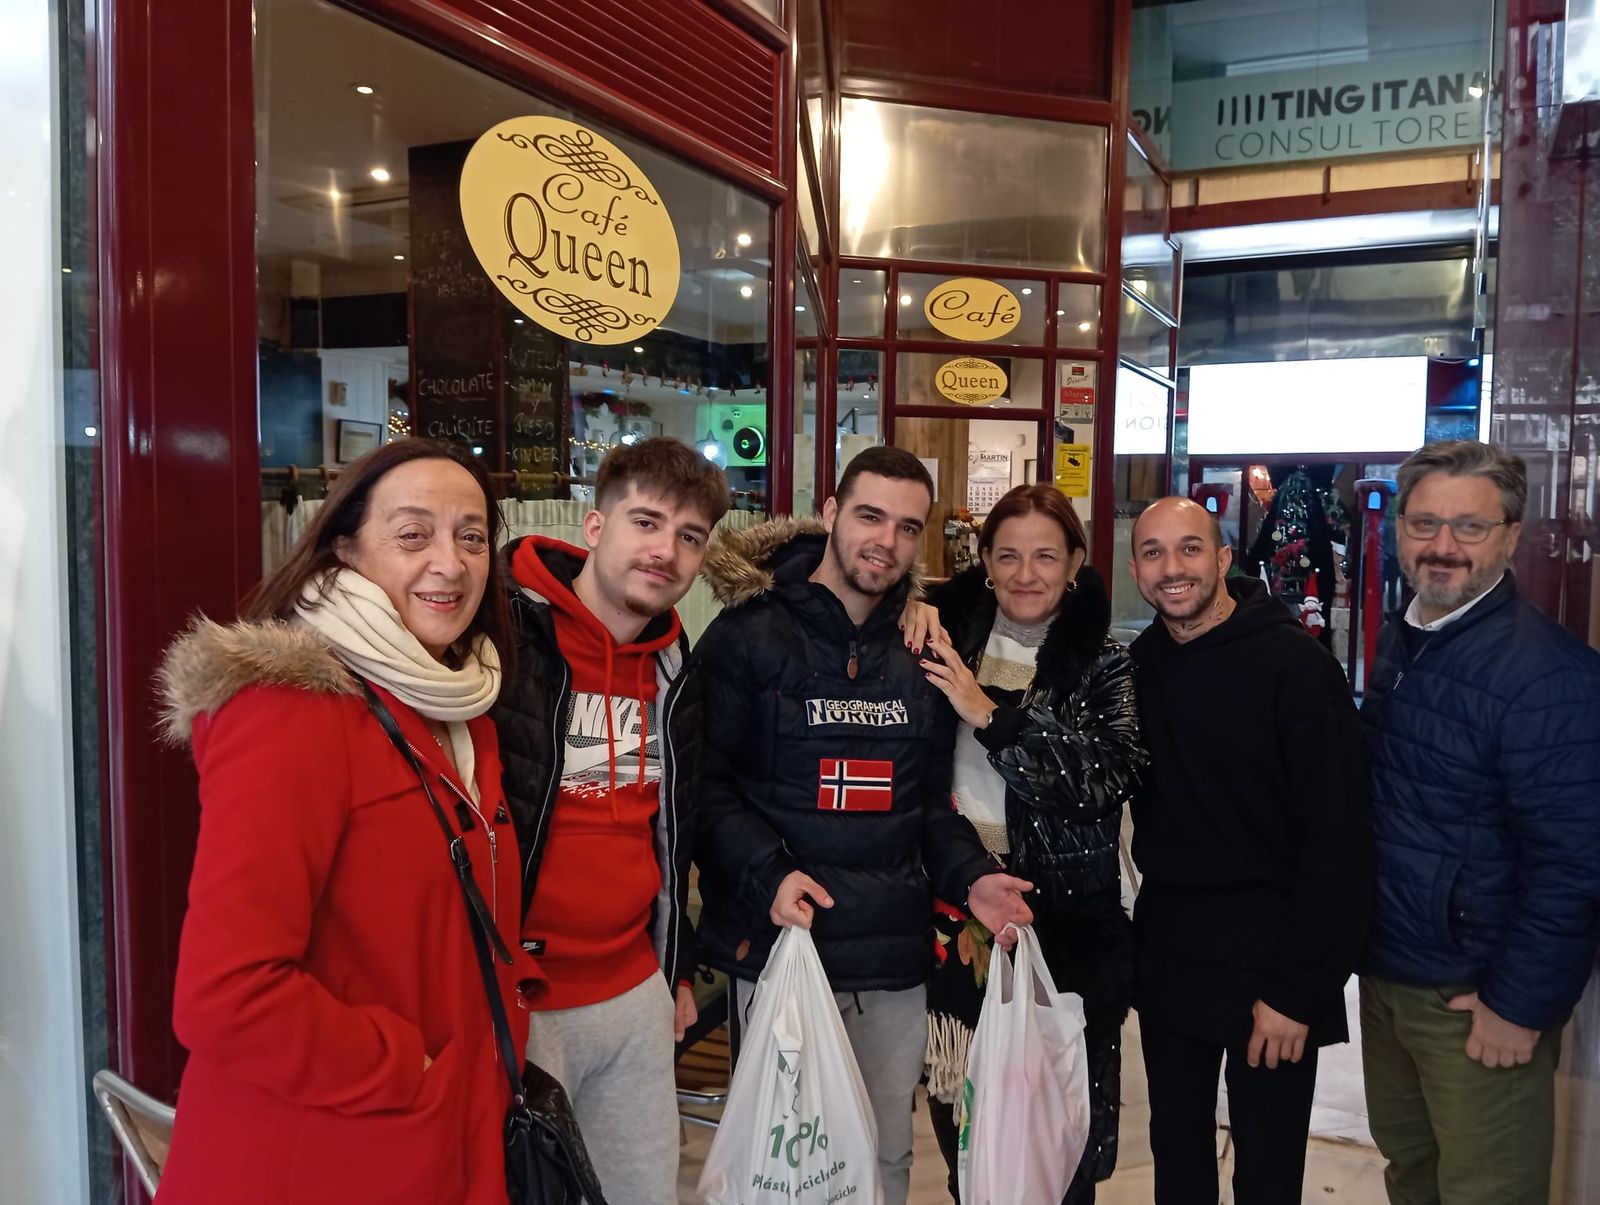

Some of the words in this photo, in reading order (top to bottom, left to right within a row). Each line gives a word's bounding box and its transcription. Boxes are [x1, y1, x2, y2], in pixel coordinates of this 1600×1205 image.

[1215, 111, 1484, 160] CONSULTORE
[542, 173, 629, 235] Café
[504, 192, 652, 298] Queen
[929, 290, 1016, 328] Café
[941, 370, 1000, 391] Queen
[568, 693, 646, 742] NIKE
[826, 699, 906, 713] GEOGRAPHICAL
